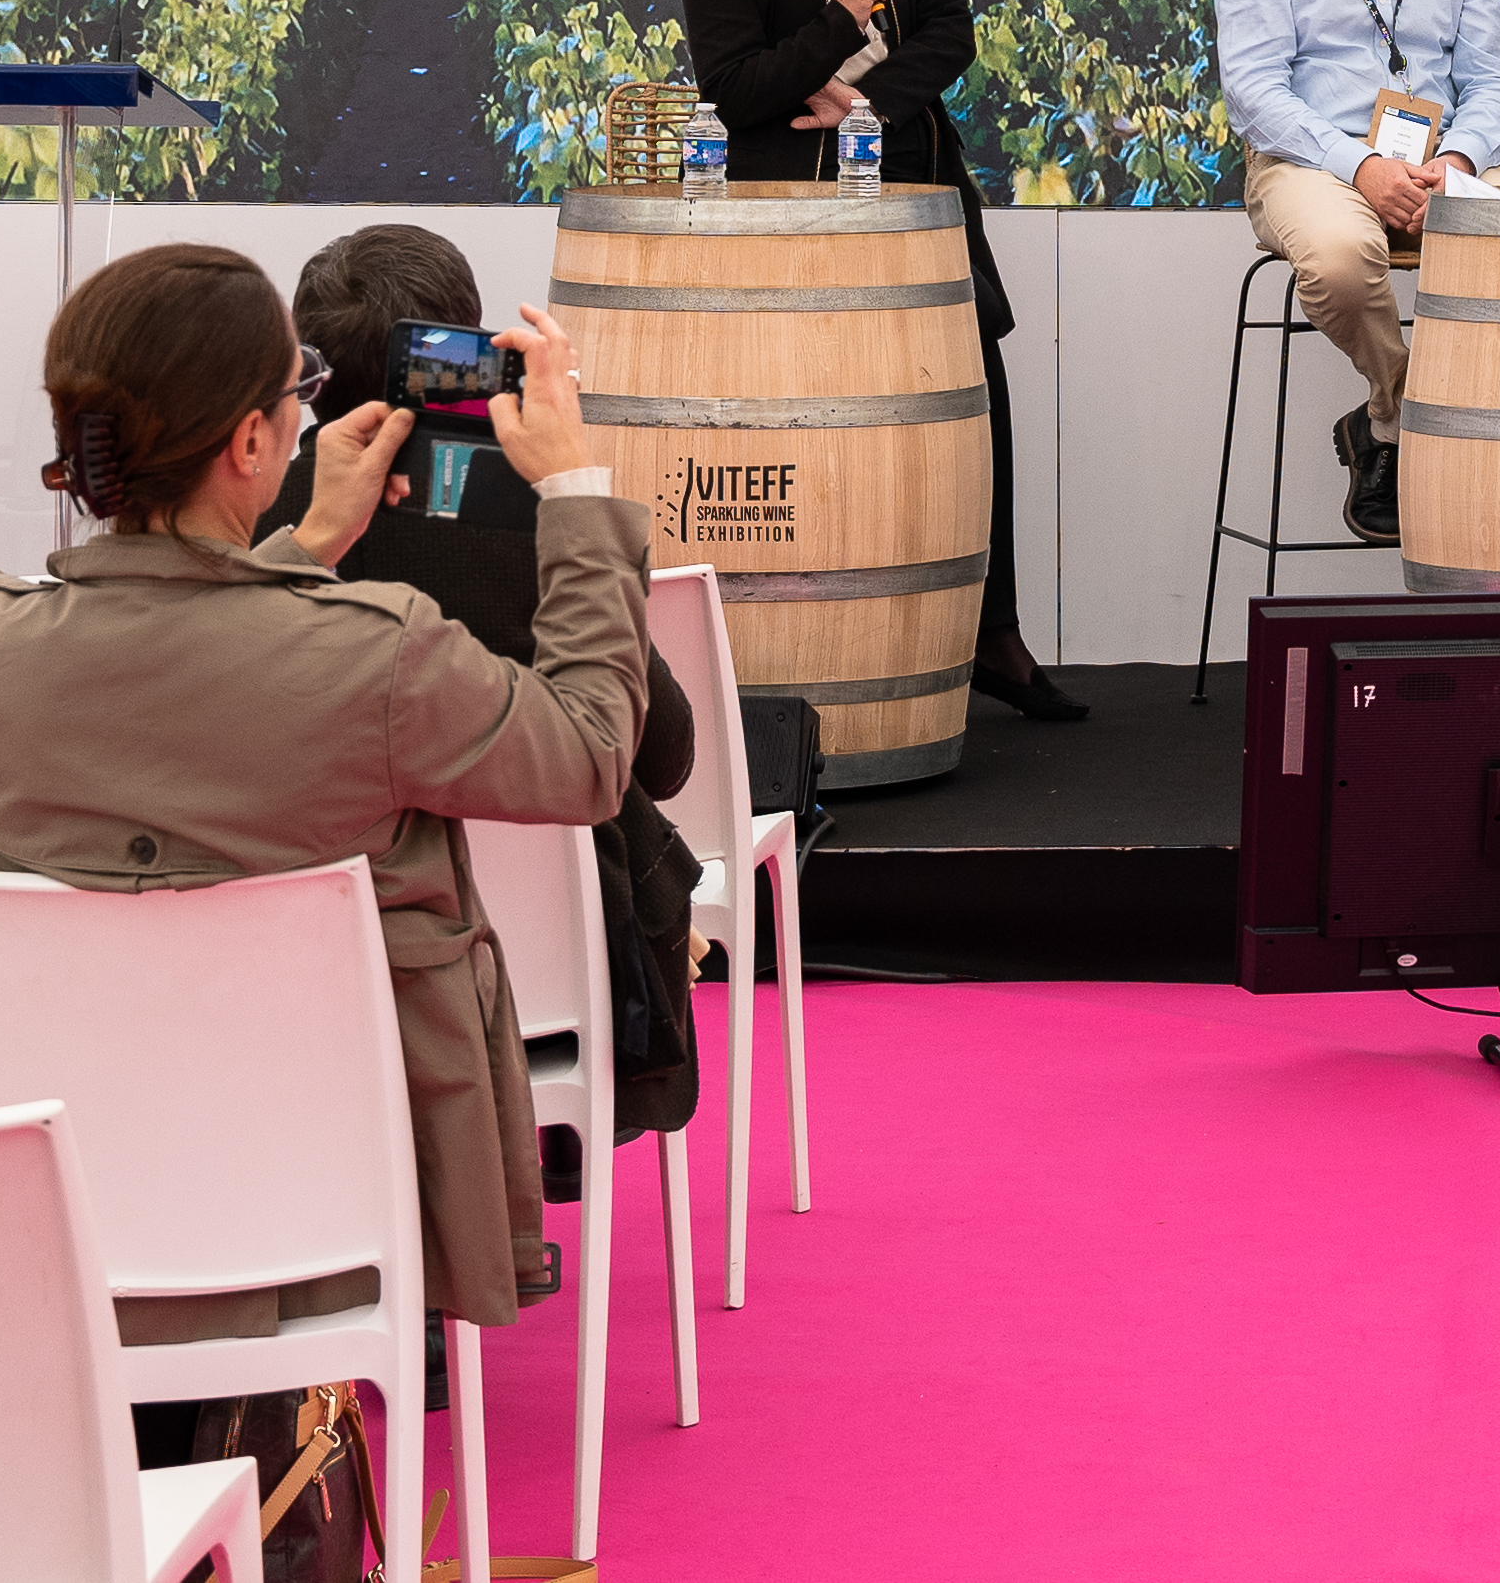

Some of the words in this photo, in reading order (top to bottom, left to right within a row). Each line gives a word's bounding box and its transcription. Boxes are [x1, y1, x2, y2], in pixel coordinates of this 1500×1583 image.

[696, 464, 796, 500] VITEFF
[697, 506, 759, 522] SPARKLING
[763, 506, 795, 522] WINE
[697, 526, 795, 542] EXHIBITION
[1354, 685, 1376, 707] 17
